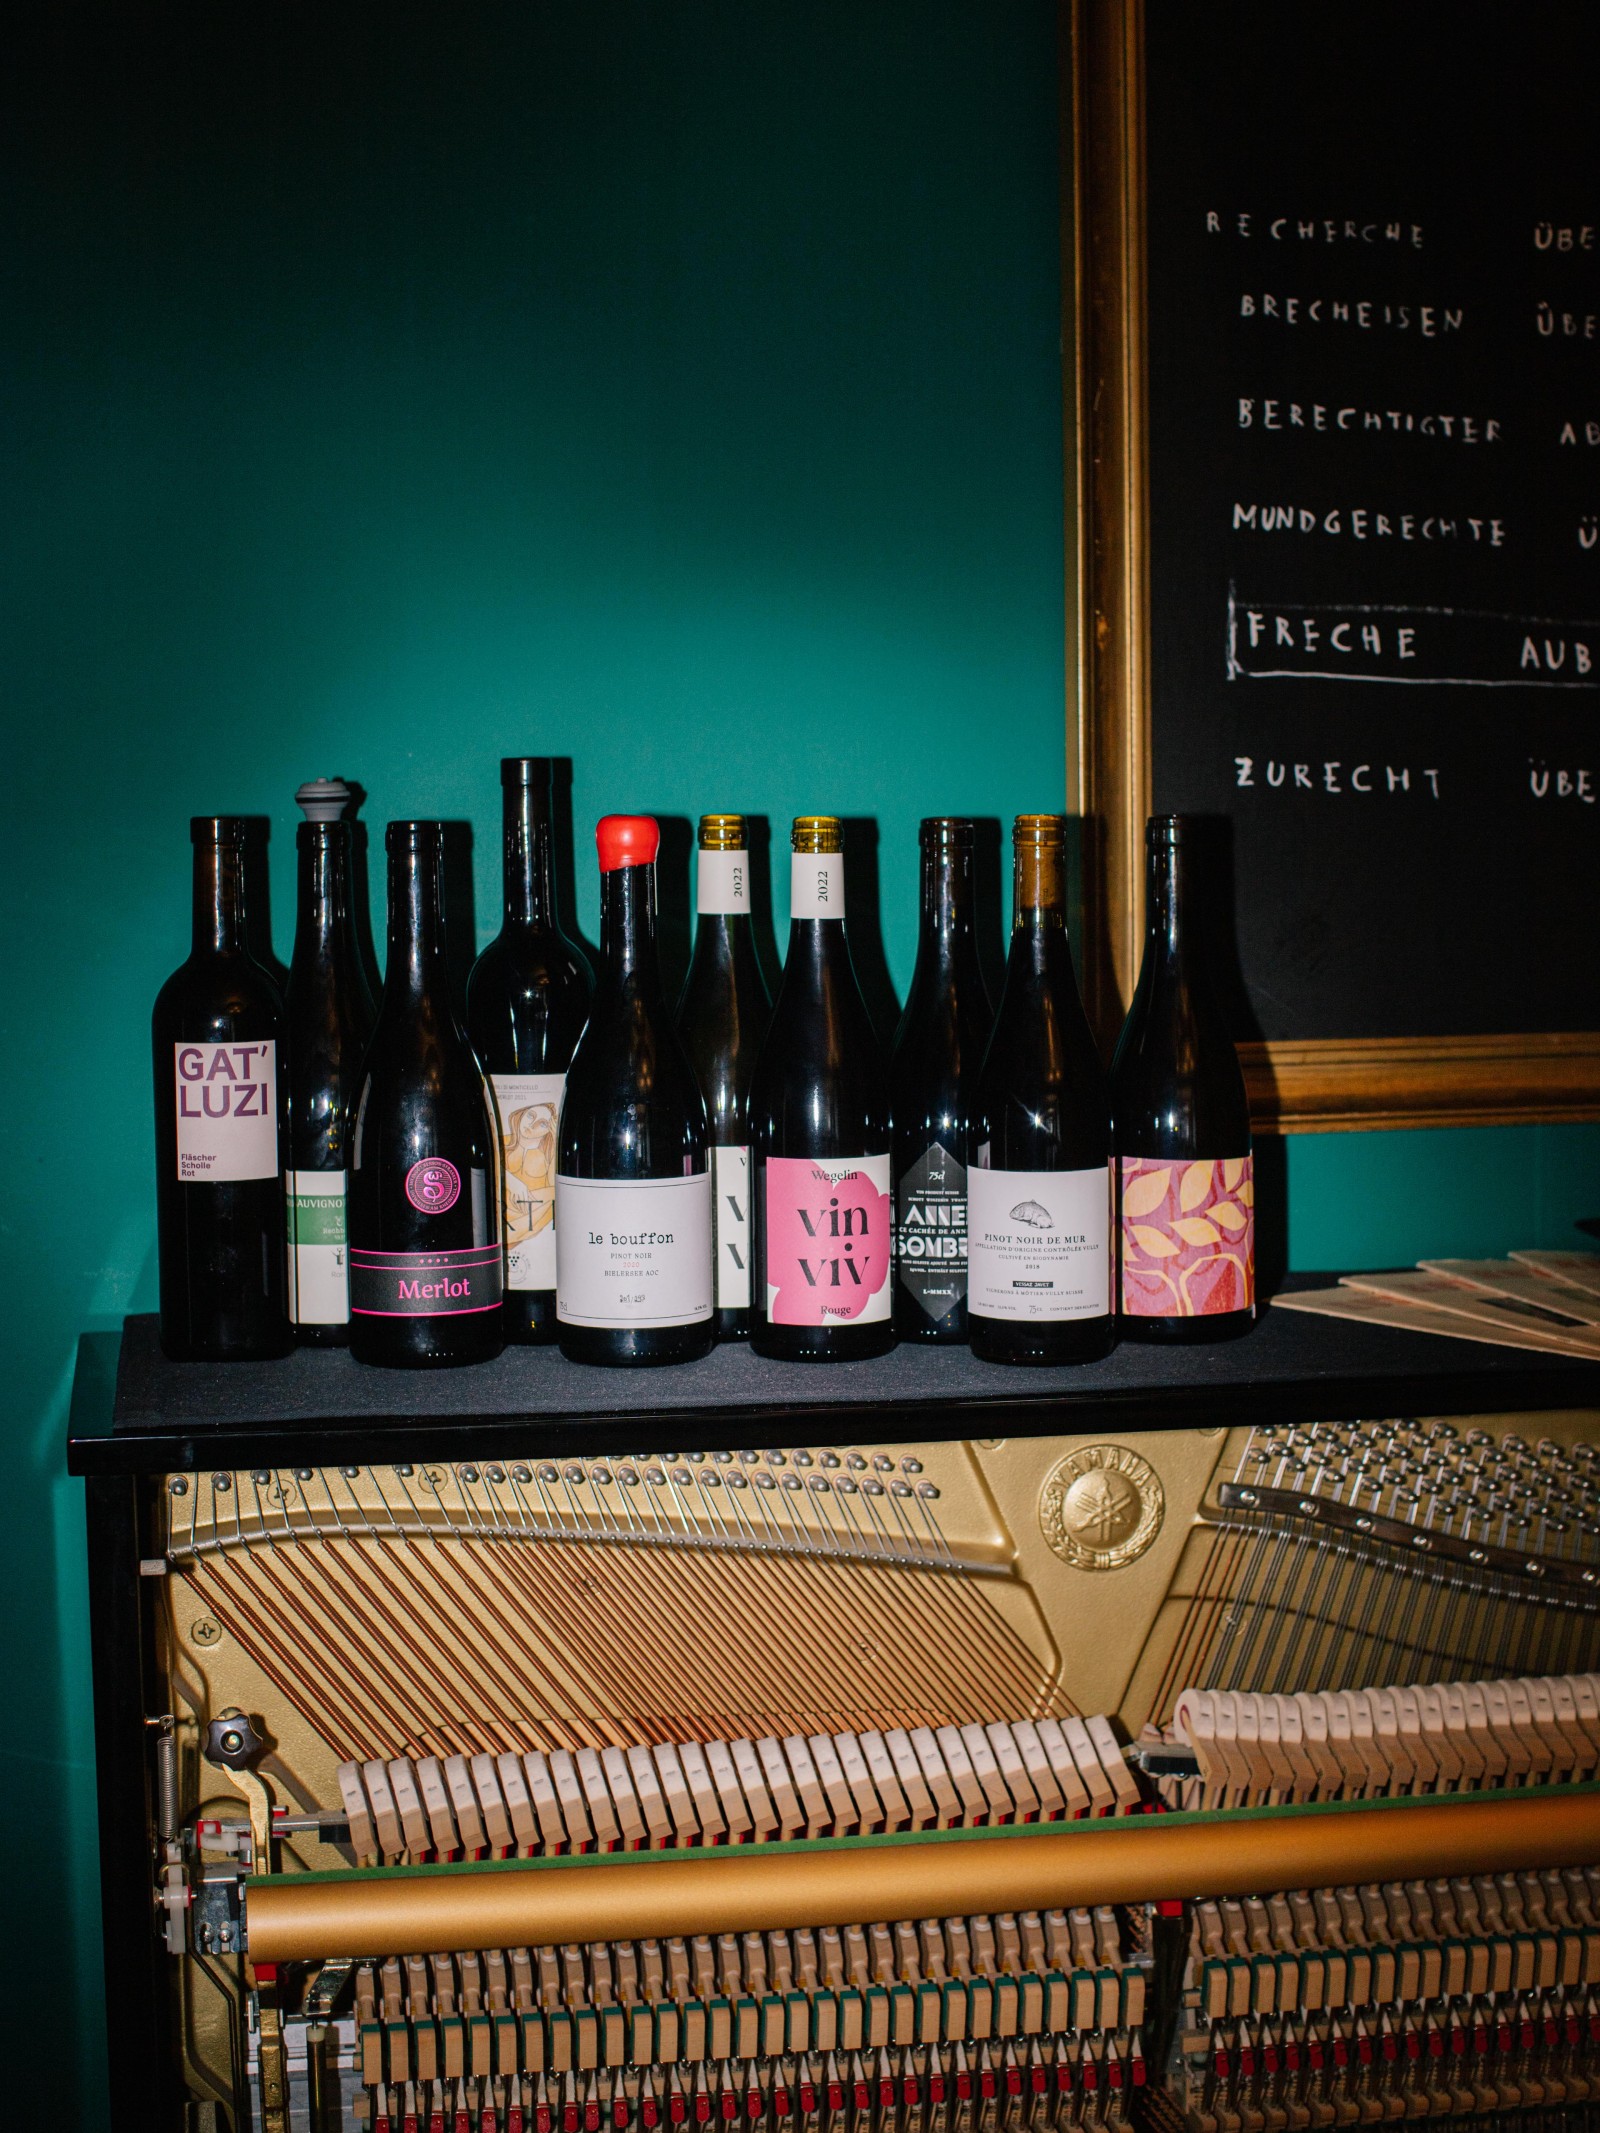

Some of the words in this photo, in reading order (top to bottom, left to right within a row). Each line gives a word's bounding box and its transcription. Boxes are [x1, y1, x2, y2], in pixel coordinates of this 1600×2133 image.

[1205, 210, 1423, 249] RECHERCHE
[1240, 293, 1464, 337] BRECHEISEN
[1237, 398, 1502, 444] BERECHTIGTER
[1232, 502, 1506, 547] MUNDGERECHTE
[1246, 610, 1416, 659] FRECHE
[1520, 635, 1592, 674] AUB
[1234, 756, 1440, 800] ZURECHT
[733, 867, 743, 898] 2022
[817, 870, 829, 903] 2022
[179, 1082, 269, 1119] LUZI
[181, 1153, 217, 1161] Fläscher
[181, 1161, 211, 1169] Scholle
[181, 1169, 196, 1177] Rot
[811, 1169, 859, 1183] Wegelin
[297, 1198, 345, 1209] AUVIGNO
[796, 1197, 870, 1237] vin
[588, 1232, 603, 1245] le
[609, 1232, 675, 1246] bouffon
[908, 1226, 936, 1235] CACHÉE
[984, 1233, 1012, 1244] PINOT
[1016, 1236, 1043, 1245] NOIR
[1047, 1236, 1061, 1244] DE
[1064, 1234, 1086, 1244] MUR
[610, 1252, 632, 1260] PINOT
[634, 1252, 653, 1260] NOIR
[975, 1242, 1007, 1251] APPELLATION
[1043, 1245, 1082, 1253] CONTRÔLÉE
[797, 1242, 871, 1287] viv
[397, 1277, 471, 1300] Merlot
[820, 1304, 852, 1316] Rouge
[1052, 1447, 1154, 1488] YAMAHA
